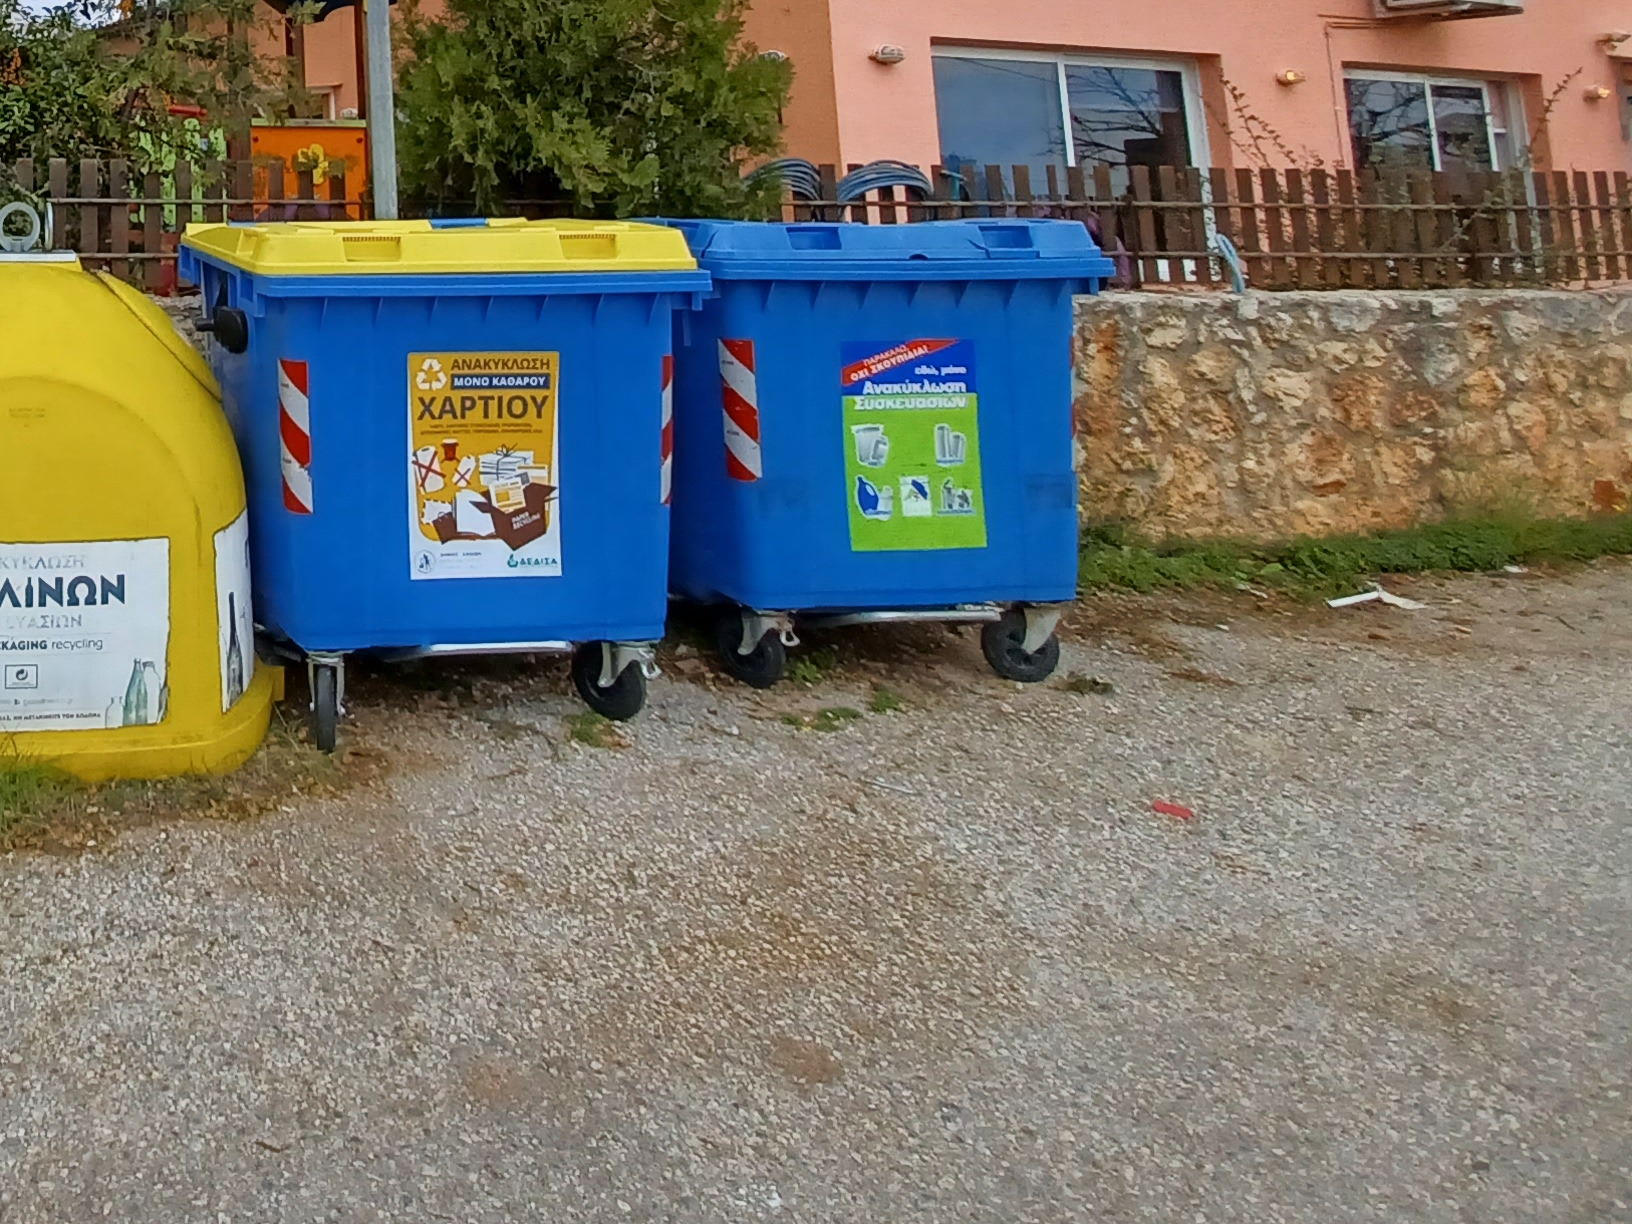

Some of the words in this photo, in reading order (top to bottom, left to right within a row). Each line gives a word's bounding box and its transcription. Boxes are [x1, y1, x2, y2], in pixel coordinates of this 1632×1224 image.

[451, 358, 550, 371] ΑΝΑΚΥΚΛΩΣΗ
[454, 376, 489, 386] ΜΟΝΟ
[492, 376, 545, 386] ΚΑΘΑΡΟΥ
[862, 379, 966, 394] Ανακύκλωση
[417, 395, 549, 420] ΧΑΡΤΙΟΥ
[519, 557, 558, 566] ΔΕΔΙΣΑ
[51, 639, 104, 651] recycling
